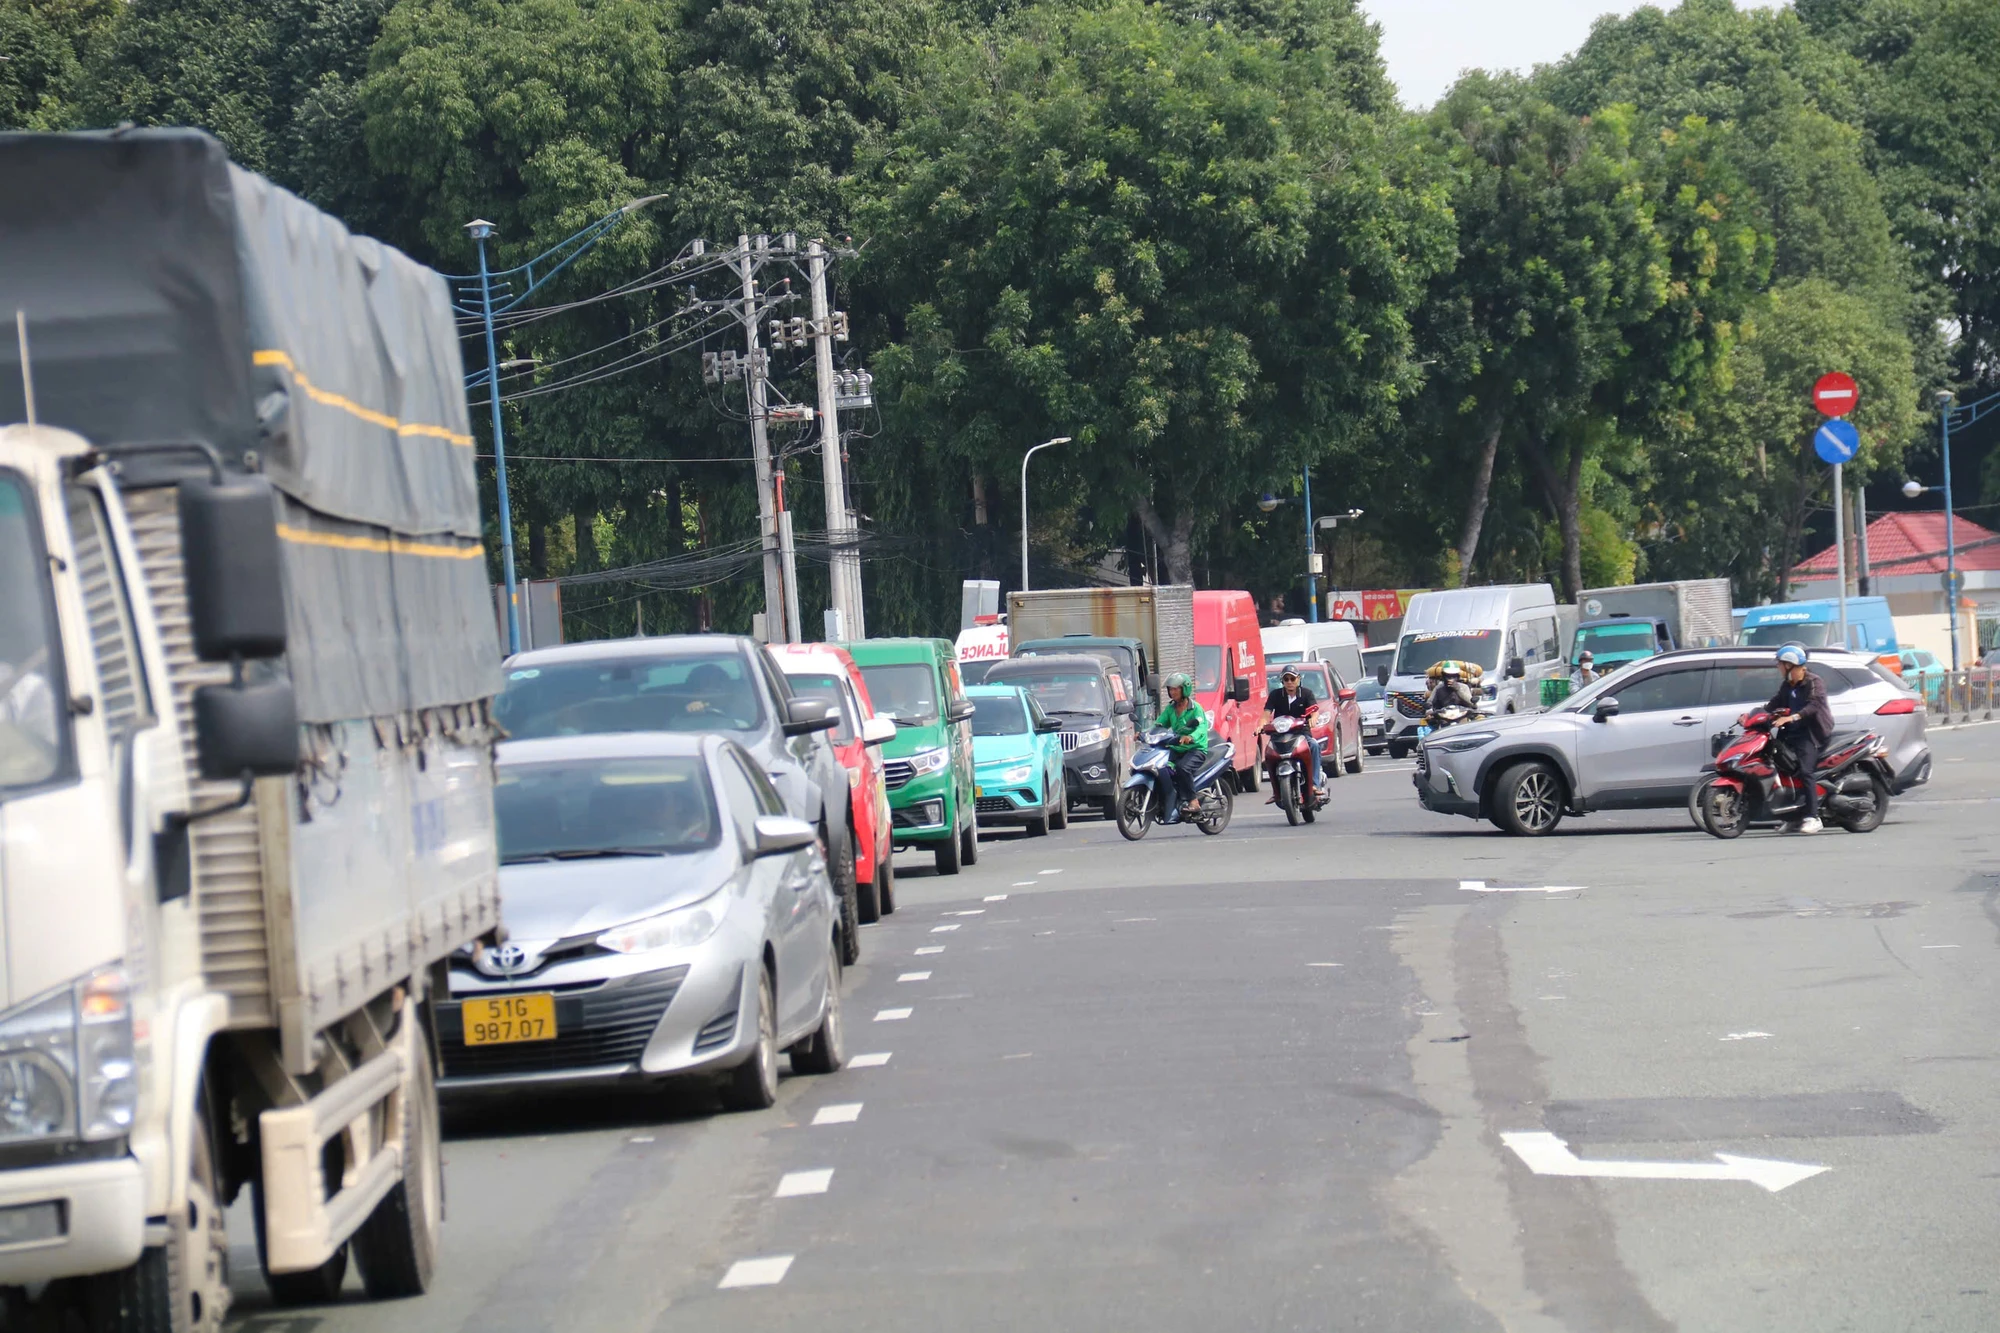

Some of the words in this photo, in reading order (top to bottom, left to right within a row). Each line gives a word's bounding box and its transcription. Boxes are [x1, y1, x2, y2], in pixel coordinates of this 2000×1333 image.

[1414, 630, 1480, 641] PERFORMANCE
[488, 999, 528, 1019] 51G
[474, 1018, 544, 1041] 987.07
